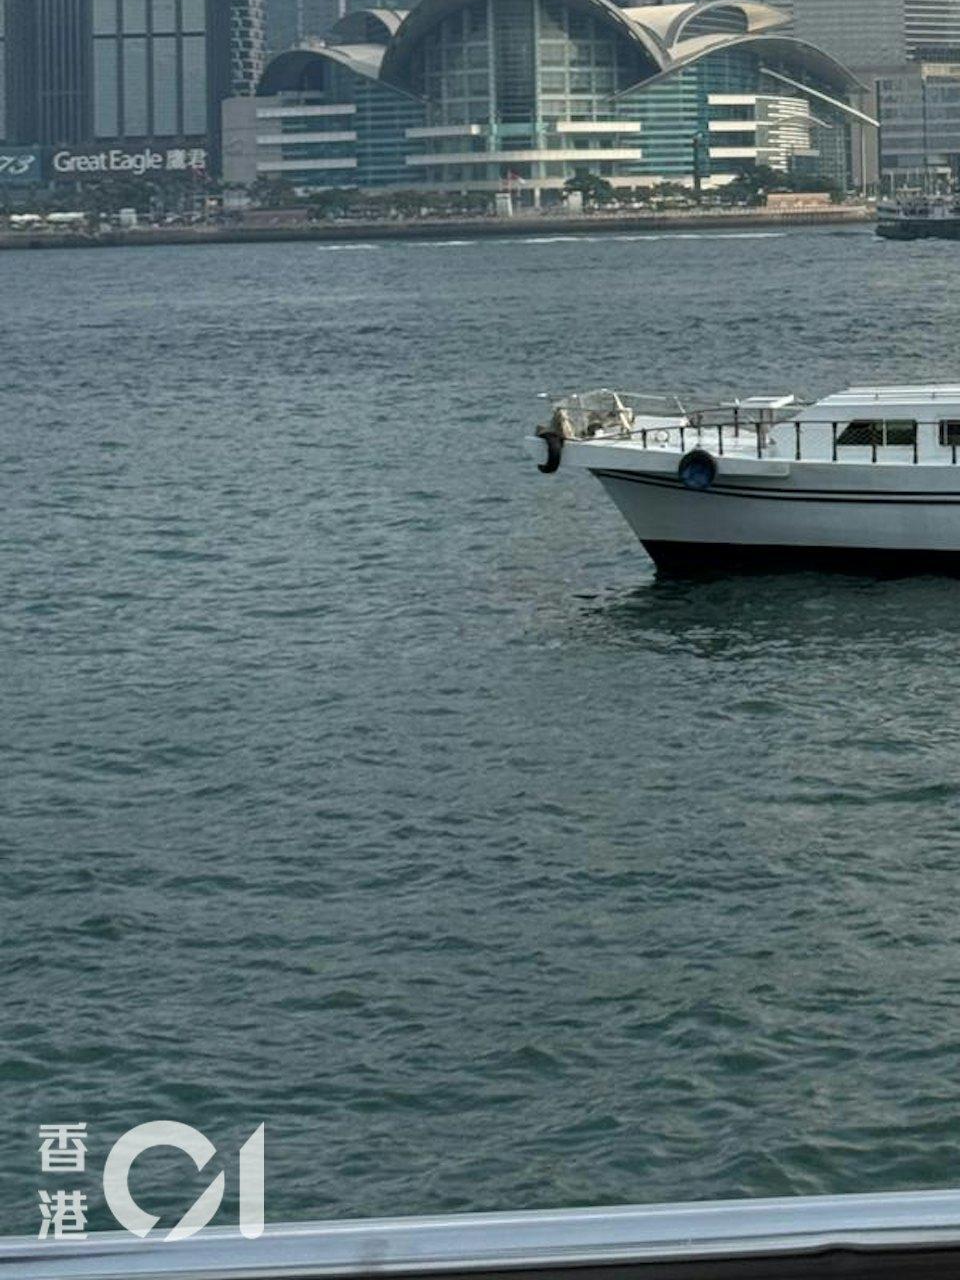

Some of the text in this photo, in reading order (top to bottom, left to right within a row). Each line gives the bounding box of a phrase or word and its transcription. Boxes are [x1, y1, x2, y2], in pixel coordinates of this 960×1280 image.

[53, 148, 207, 175] Great Eagle 鷹君
